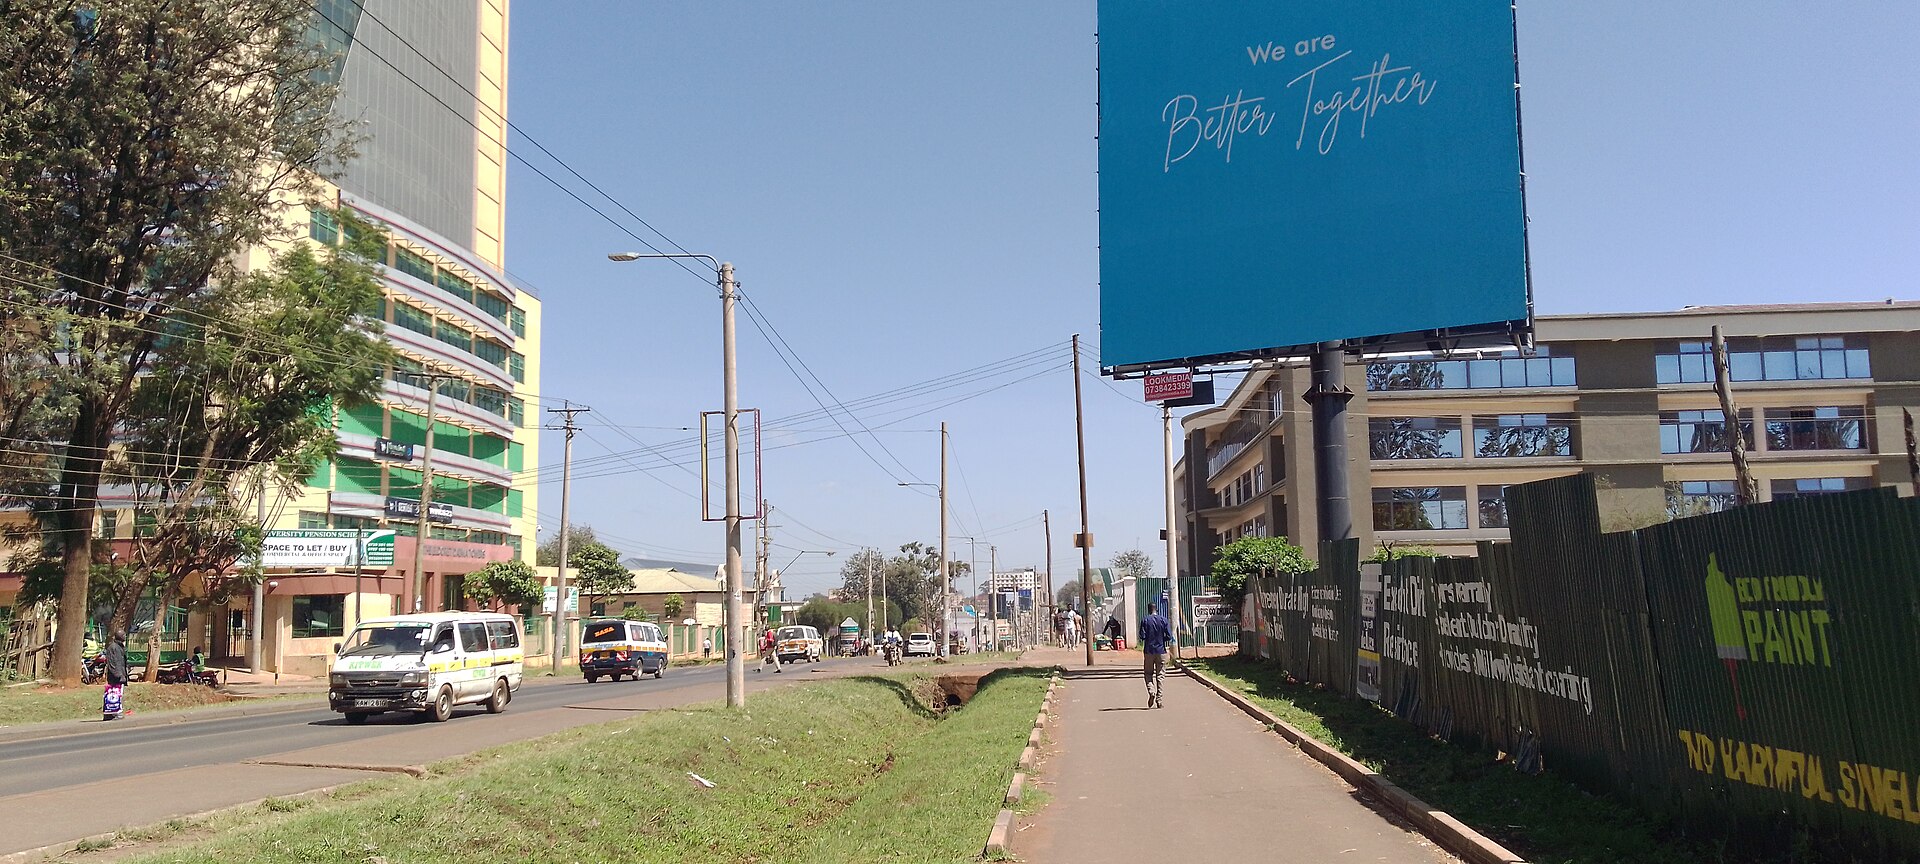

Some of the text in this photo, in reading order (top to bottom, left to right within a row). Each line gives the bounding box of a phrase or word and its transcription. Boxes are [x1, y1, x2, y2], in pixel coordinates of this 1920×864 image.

[1247, 34, 1336, 66] We are
[1162, 50, 1437, 173] Better Together
[1145, 373, 1190, 386] LOOKMEDIA
[263, 544, 291, 552] SPACE
[293, 544, 305, 552] TO
[306, 544, 323, 552] LET
[329, 544, 348, 552] BUY
[1742, 609, 1831, 668] PAINT
[1679, 729, 1920, 825] NO HARMFUL SMEL
